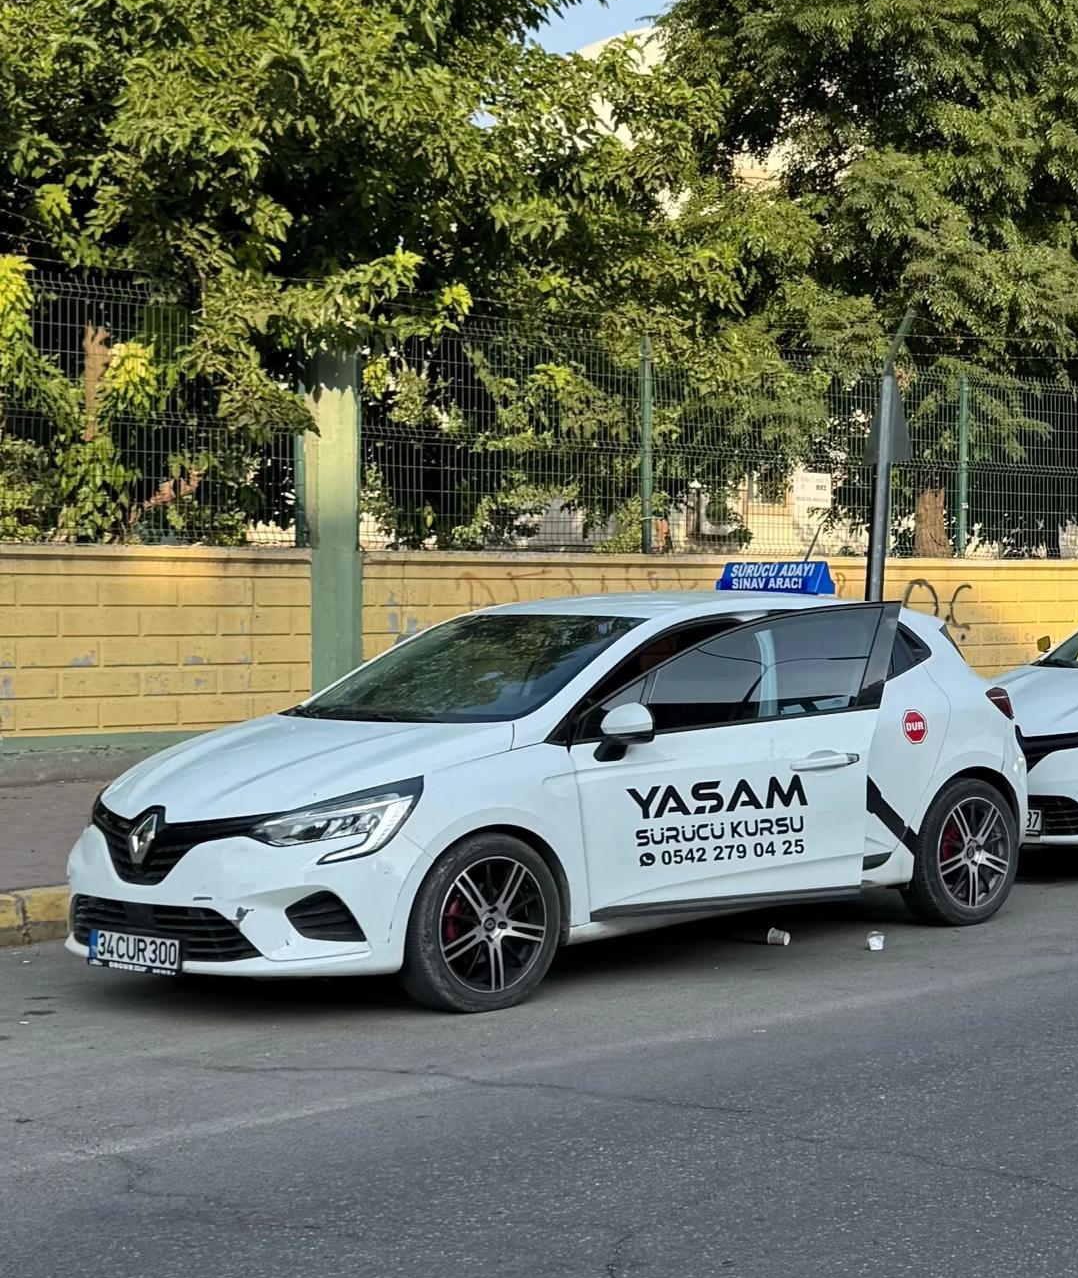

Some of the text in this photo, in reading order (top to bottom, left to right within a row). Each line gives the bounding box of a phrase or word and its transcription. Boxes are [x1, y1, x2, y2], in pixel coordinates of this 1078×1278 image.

[730, 562, 815, 578] SÜRÜCÜ ADAYI
[732, 578, 802, 589] SINAV ARACI
[905, 721, 924, 732] DUR
[635, 815, 805, 847] SÜRÜCÜ KURSU
[661, 838, 805, 866] 0542 279 04 25
